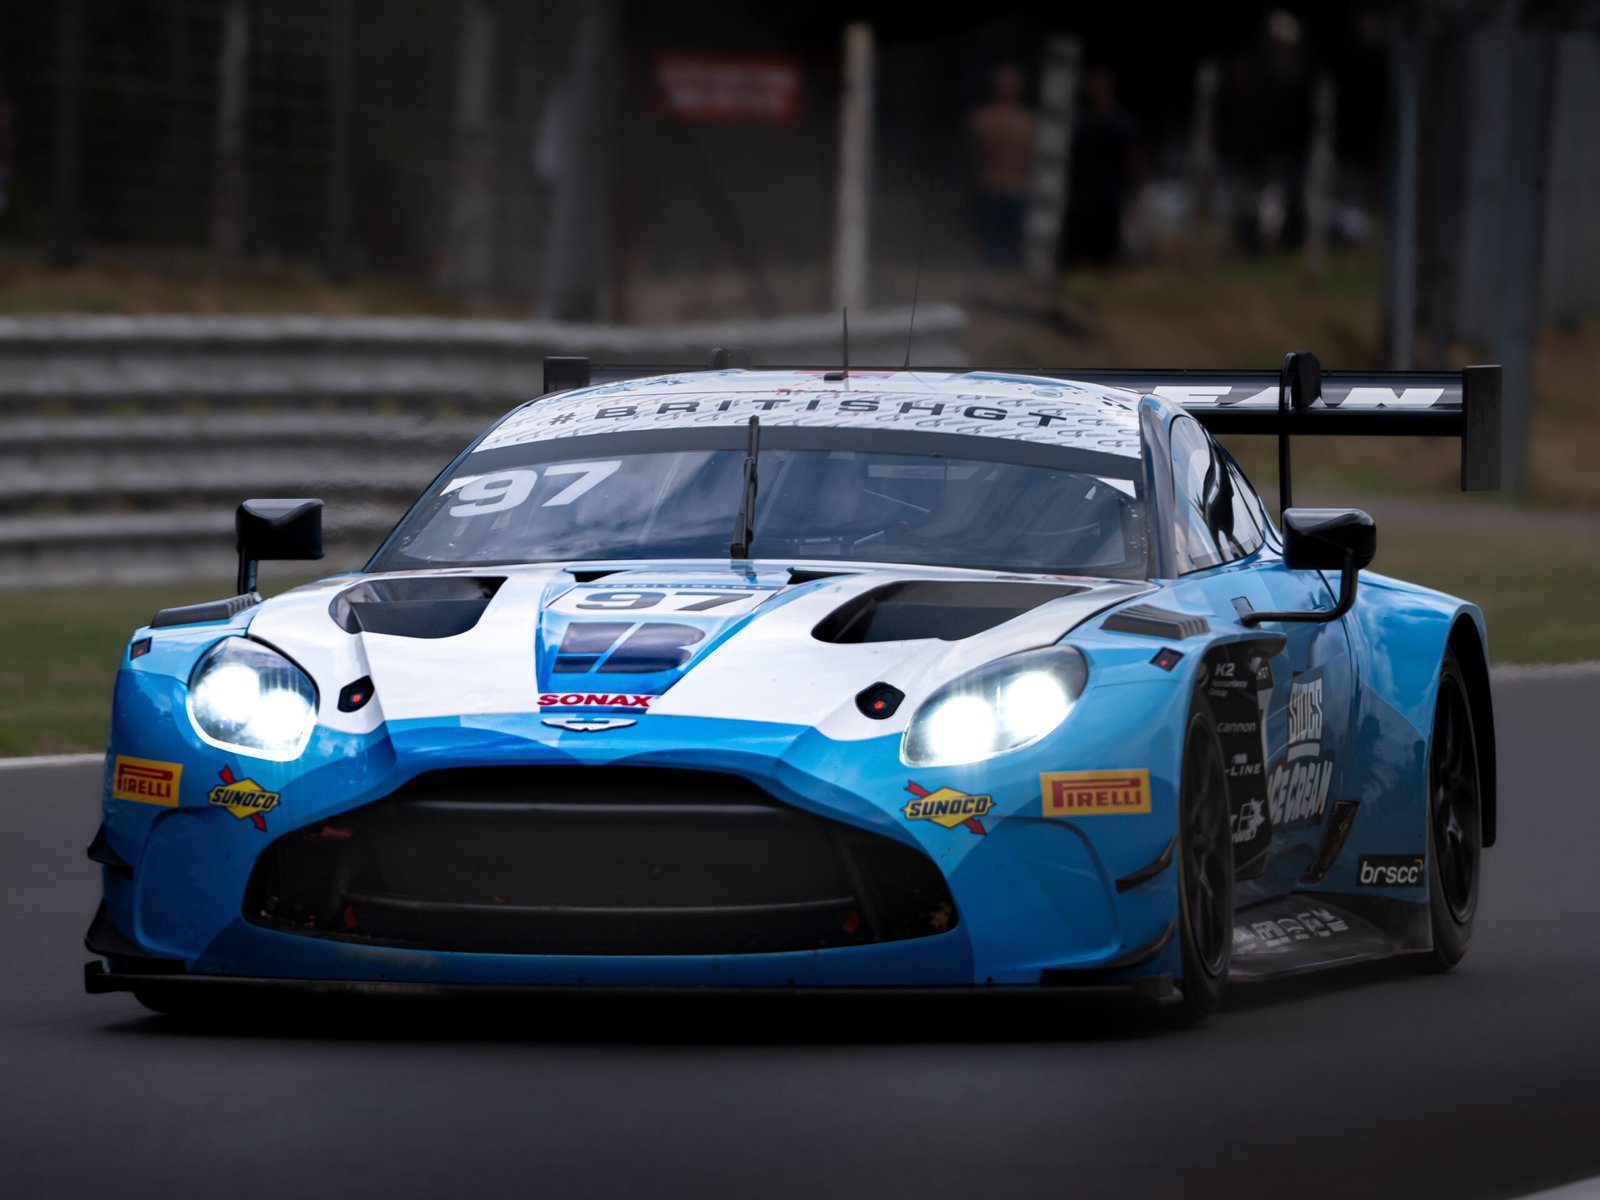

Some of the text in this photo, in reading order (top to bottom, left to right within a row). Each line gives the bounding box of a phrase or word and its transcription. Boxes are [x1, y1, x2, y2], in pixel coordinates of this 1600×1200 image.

[550, 399, 1067, 427] #BRITISHGT
[450, 460, 622, 517] 97
[576, 591, 754, 612] 97
[1214, 663, 1236, 676] K2
[537, 694, 653, 708] SONAX
[1216, 722, 1256, 733] cannon
[117, 763, 173, 798] PIRELLI
[212, 788, 276, 809] SUNOCO
[1052, 777, 1142, 808] PIRELLI
[908, 798, 989, 817] SUNOCO
[1360, 861, 1419, 884] brscc
